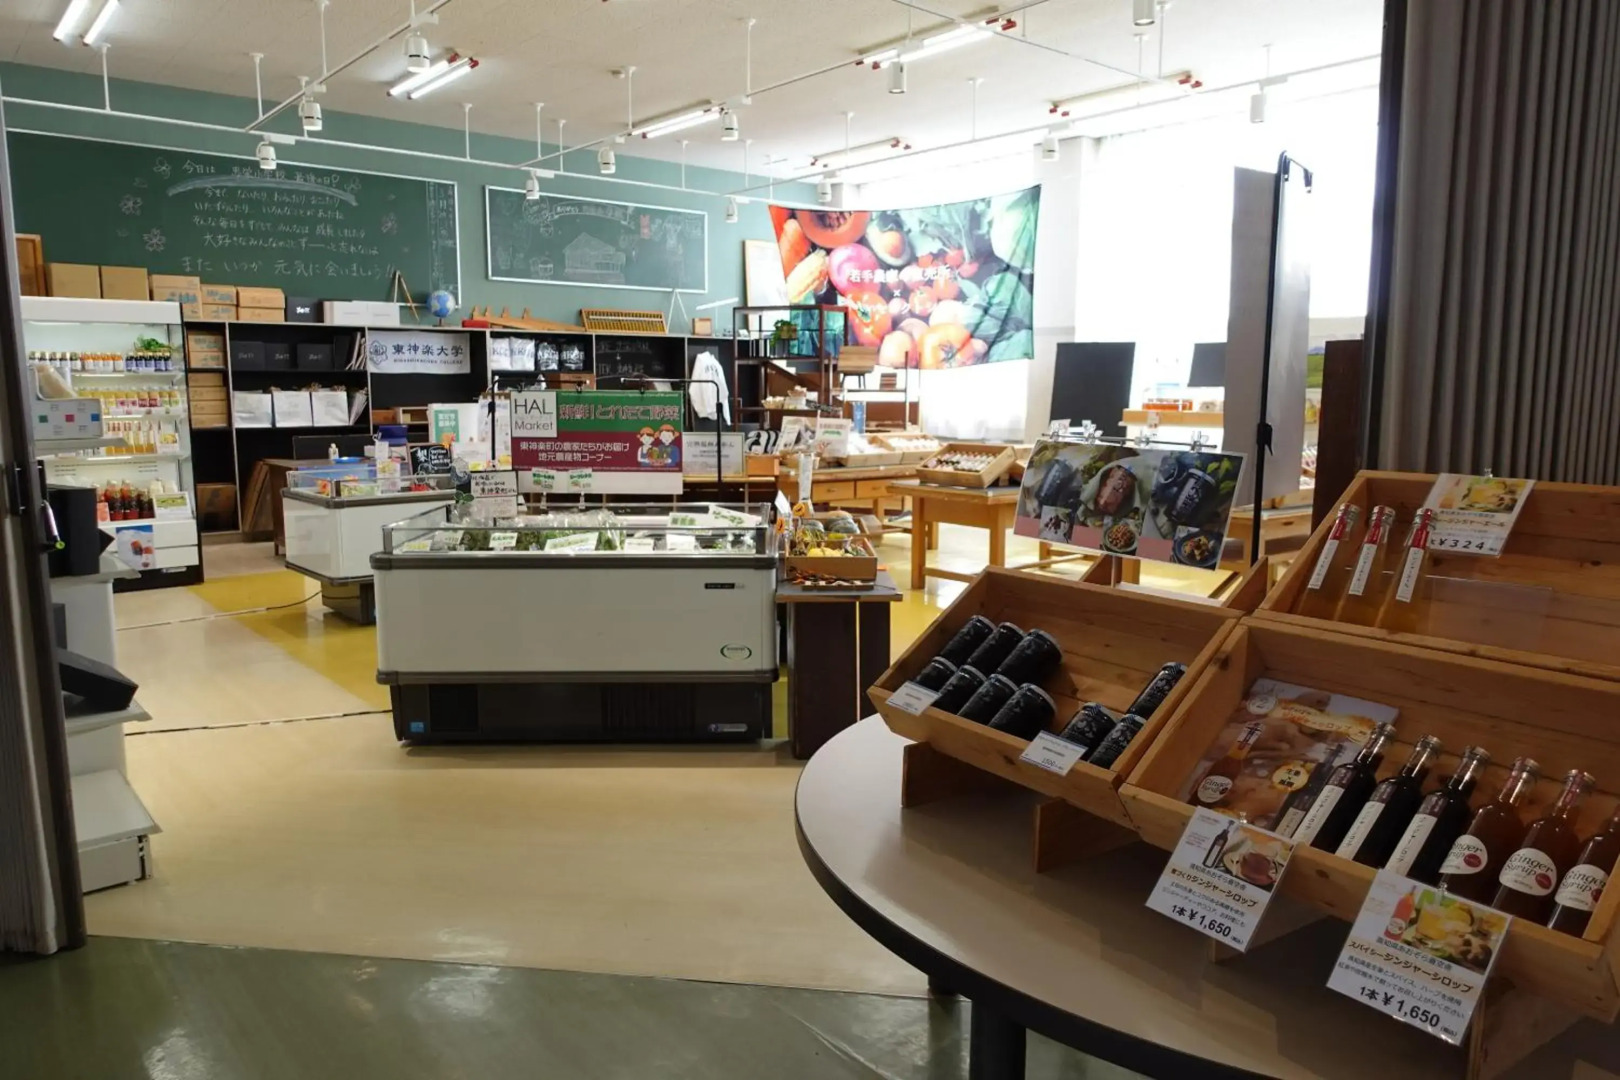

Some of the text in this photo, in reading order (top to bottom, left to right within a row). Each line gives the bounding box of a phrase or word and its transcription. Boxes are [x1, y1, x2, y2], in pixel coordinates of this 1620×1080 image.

[181, 256, 213, 272] また
[223, 260, 262, 274] いつか
[274, 259, 319, 277] 元気に
[392, 342, 464, 357] 東神楽大学
[514, 398, 553, 415] HAL
[514, 420, 553, 431] Market
[520, 441, 630, 453] 東神楽町の農家たちがお届け
[538, 453, 612, 463] 地元農産物コーナー
[1504, 864, 1537, 876] Syrup
[1509, 853, 1554, 873] Ginger
[1560, 880, 1592, 893] Syrup
[1348, 941, 1474, 993] スパイシージンジャーシロップ
